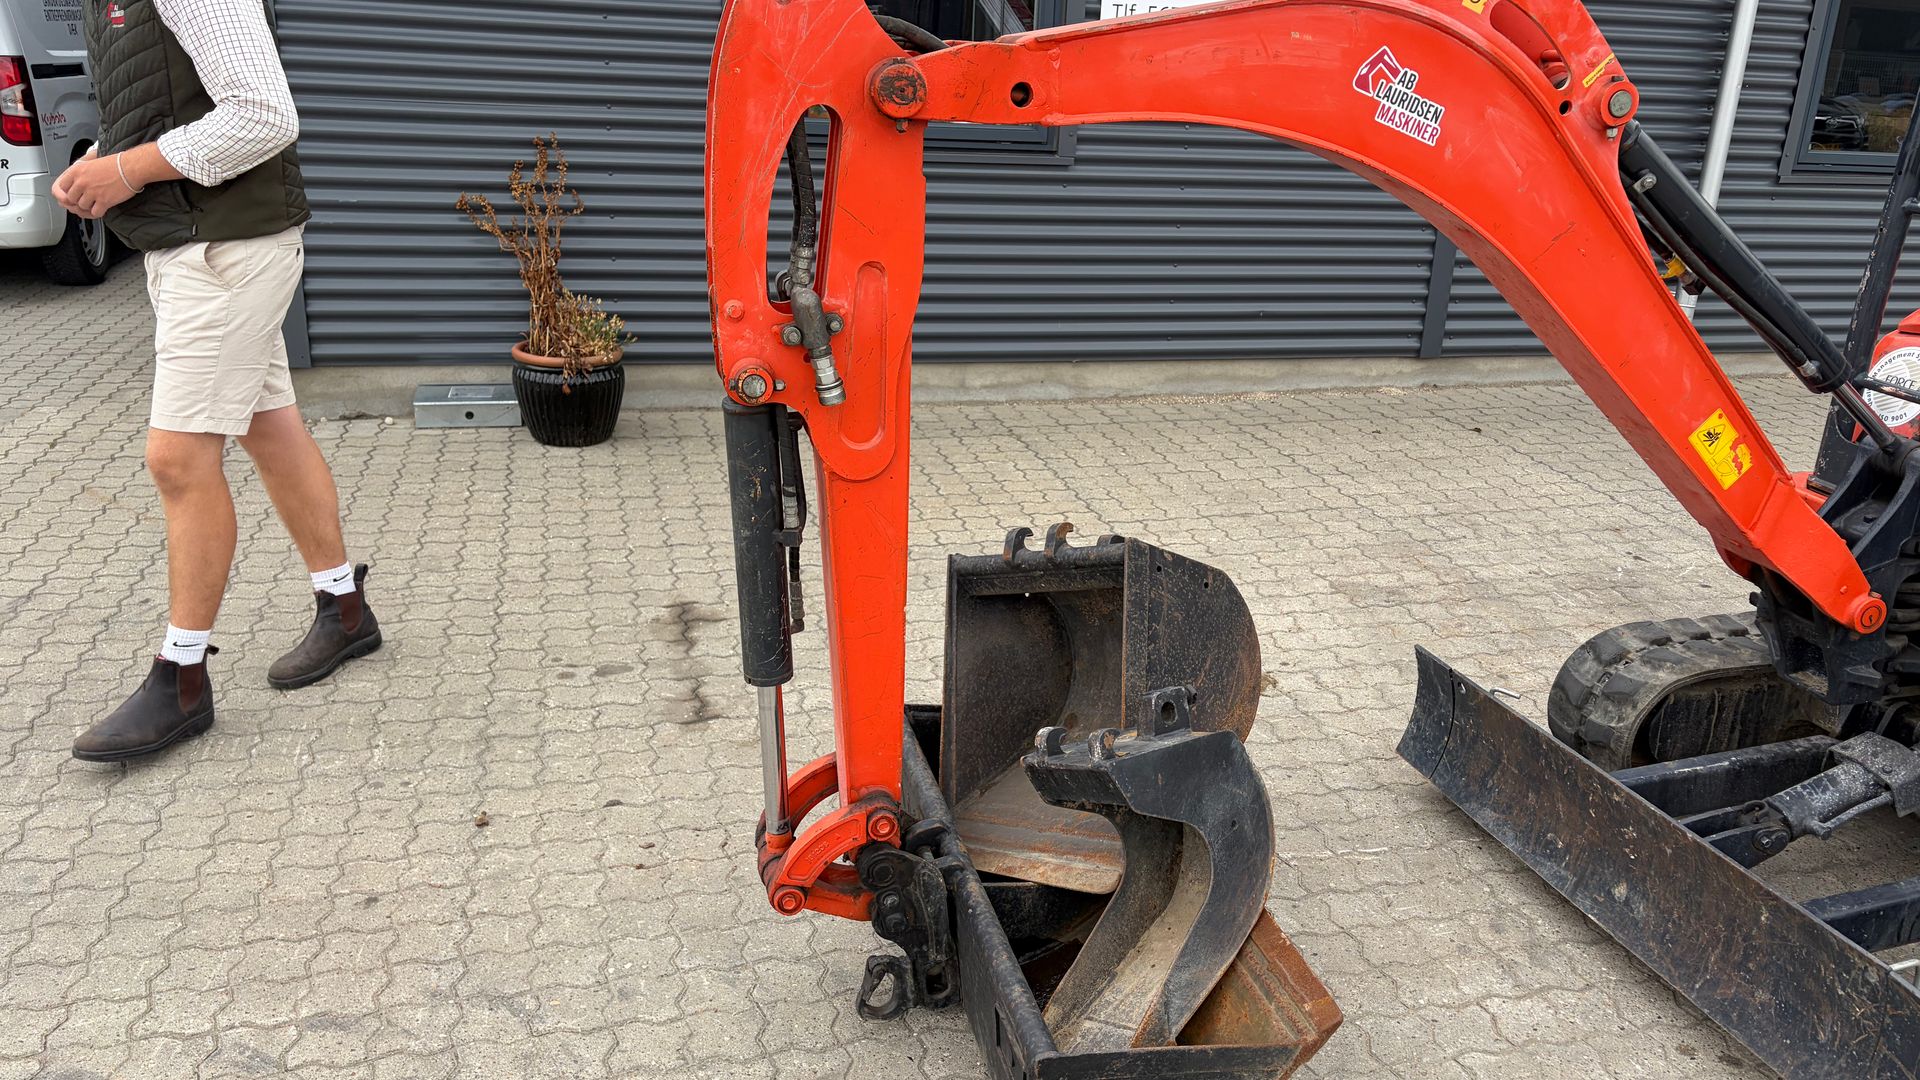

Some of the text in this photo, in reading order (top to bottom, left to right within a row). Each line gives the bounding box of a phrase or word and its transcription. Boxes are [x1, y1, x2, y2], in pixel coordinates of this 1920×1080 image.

[1397, 70, 1417, 90] AB
[1375, 81, 1442, 124] LAURIDSEN
[1376, 104, 1439, 143] MASKINER
[1872, 352, 1915, 378] Management
